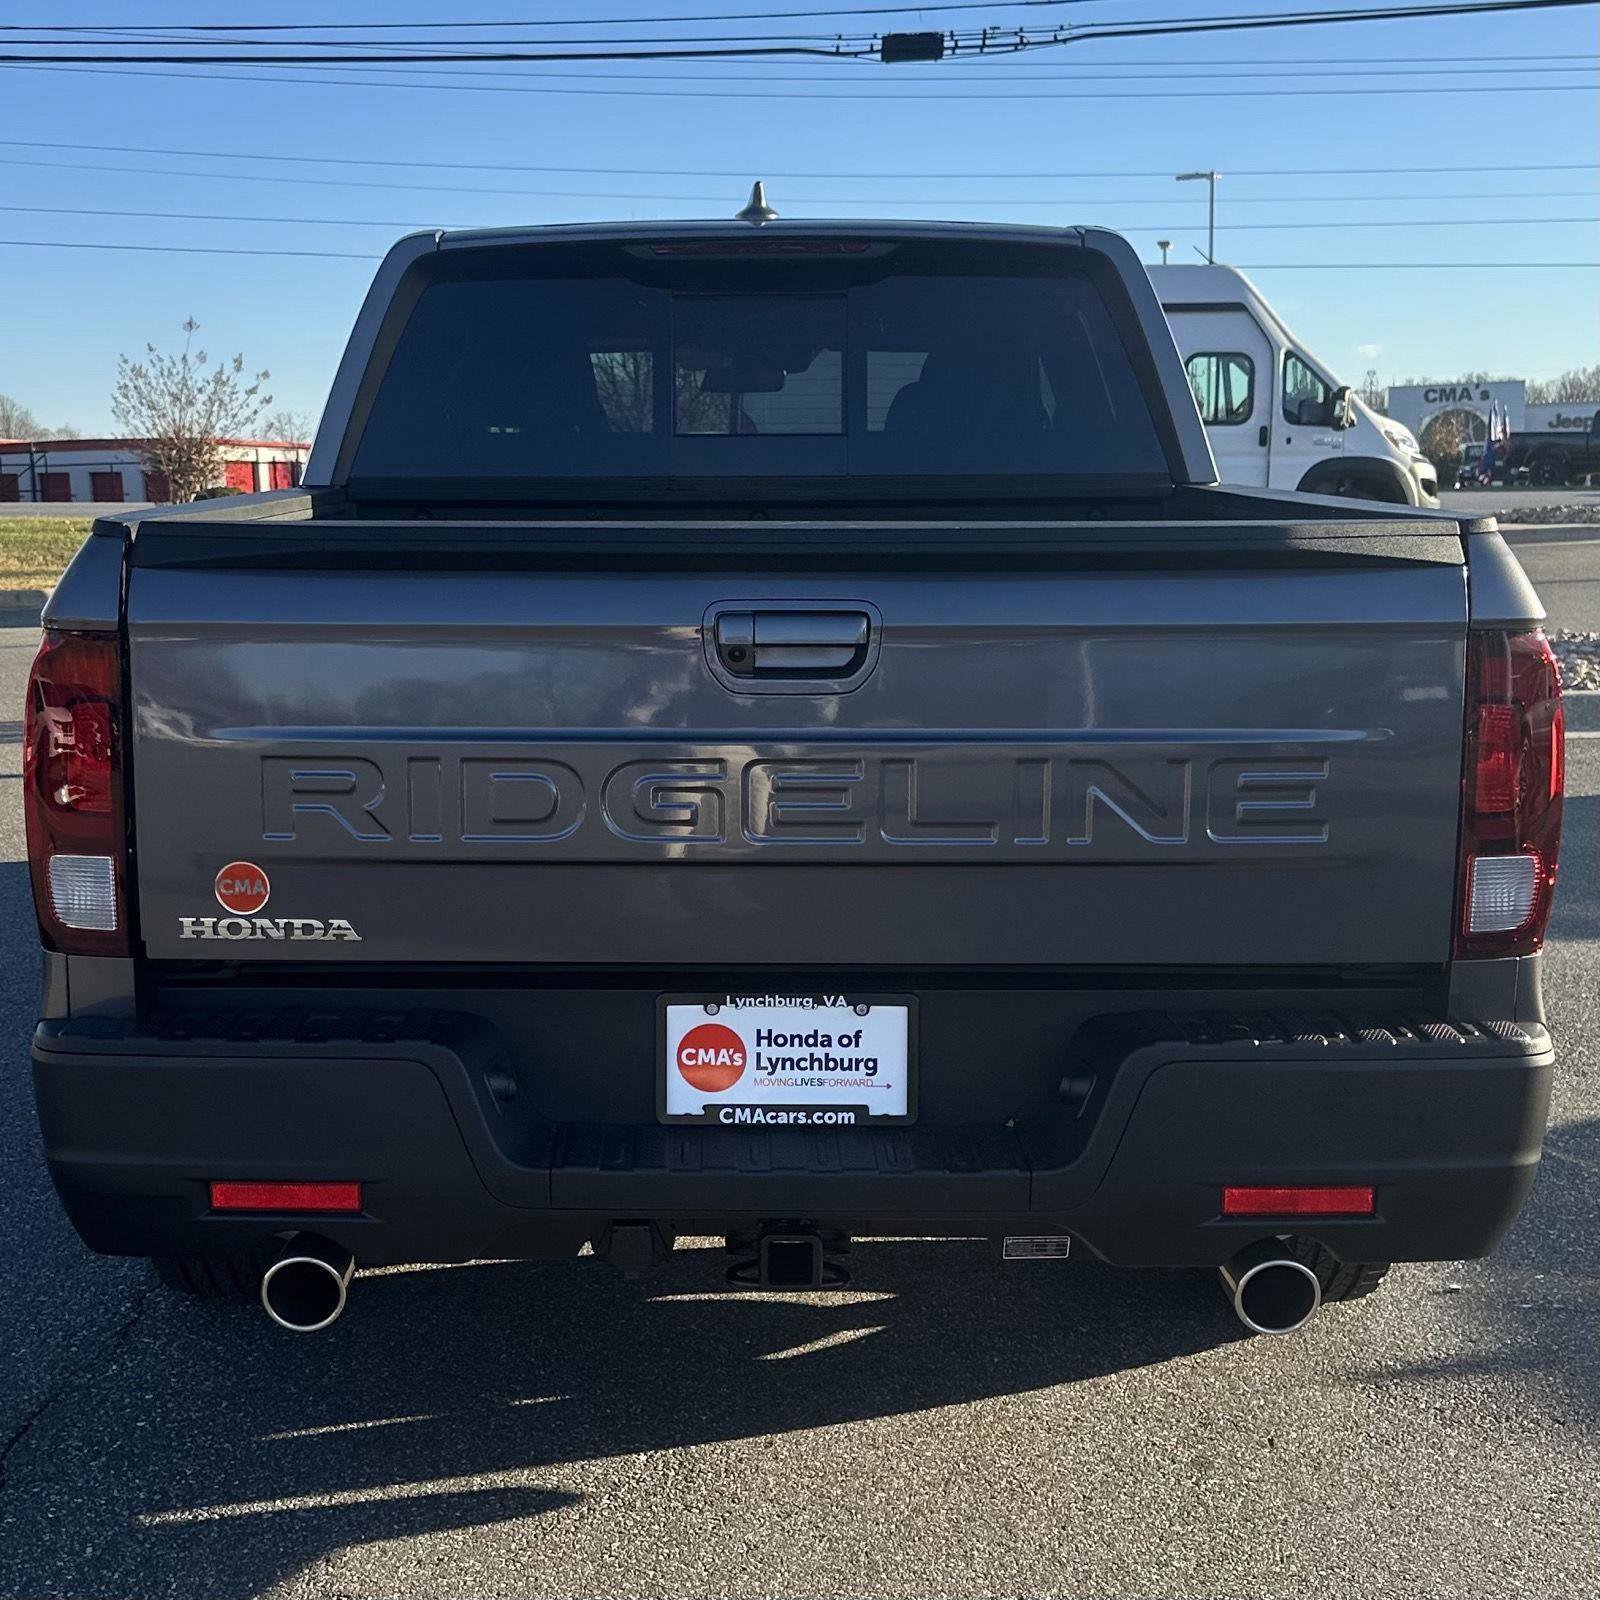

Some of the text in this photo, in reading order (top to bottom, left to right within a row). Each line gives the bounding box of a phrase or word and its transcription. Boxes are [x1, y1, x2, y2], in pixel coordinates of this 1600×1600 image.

[1423, 383, 1490, 404] CMA's
[260, 755, 1331, 846] RIDGELINE
[219, 879, 267, 896] CMA
[178, 917, 363, 941] HONDA
[725, 995, 848, 1010] Lynchburg, VA
[756, 1029, 863, 1048] Honda of
[680, 1048, 743, 1067] CMA's
[756, 1052, 879, 1077] Lynchburg
[719, 1107, 856, 1125] CMAcars.com
